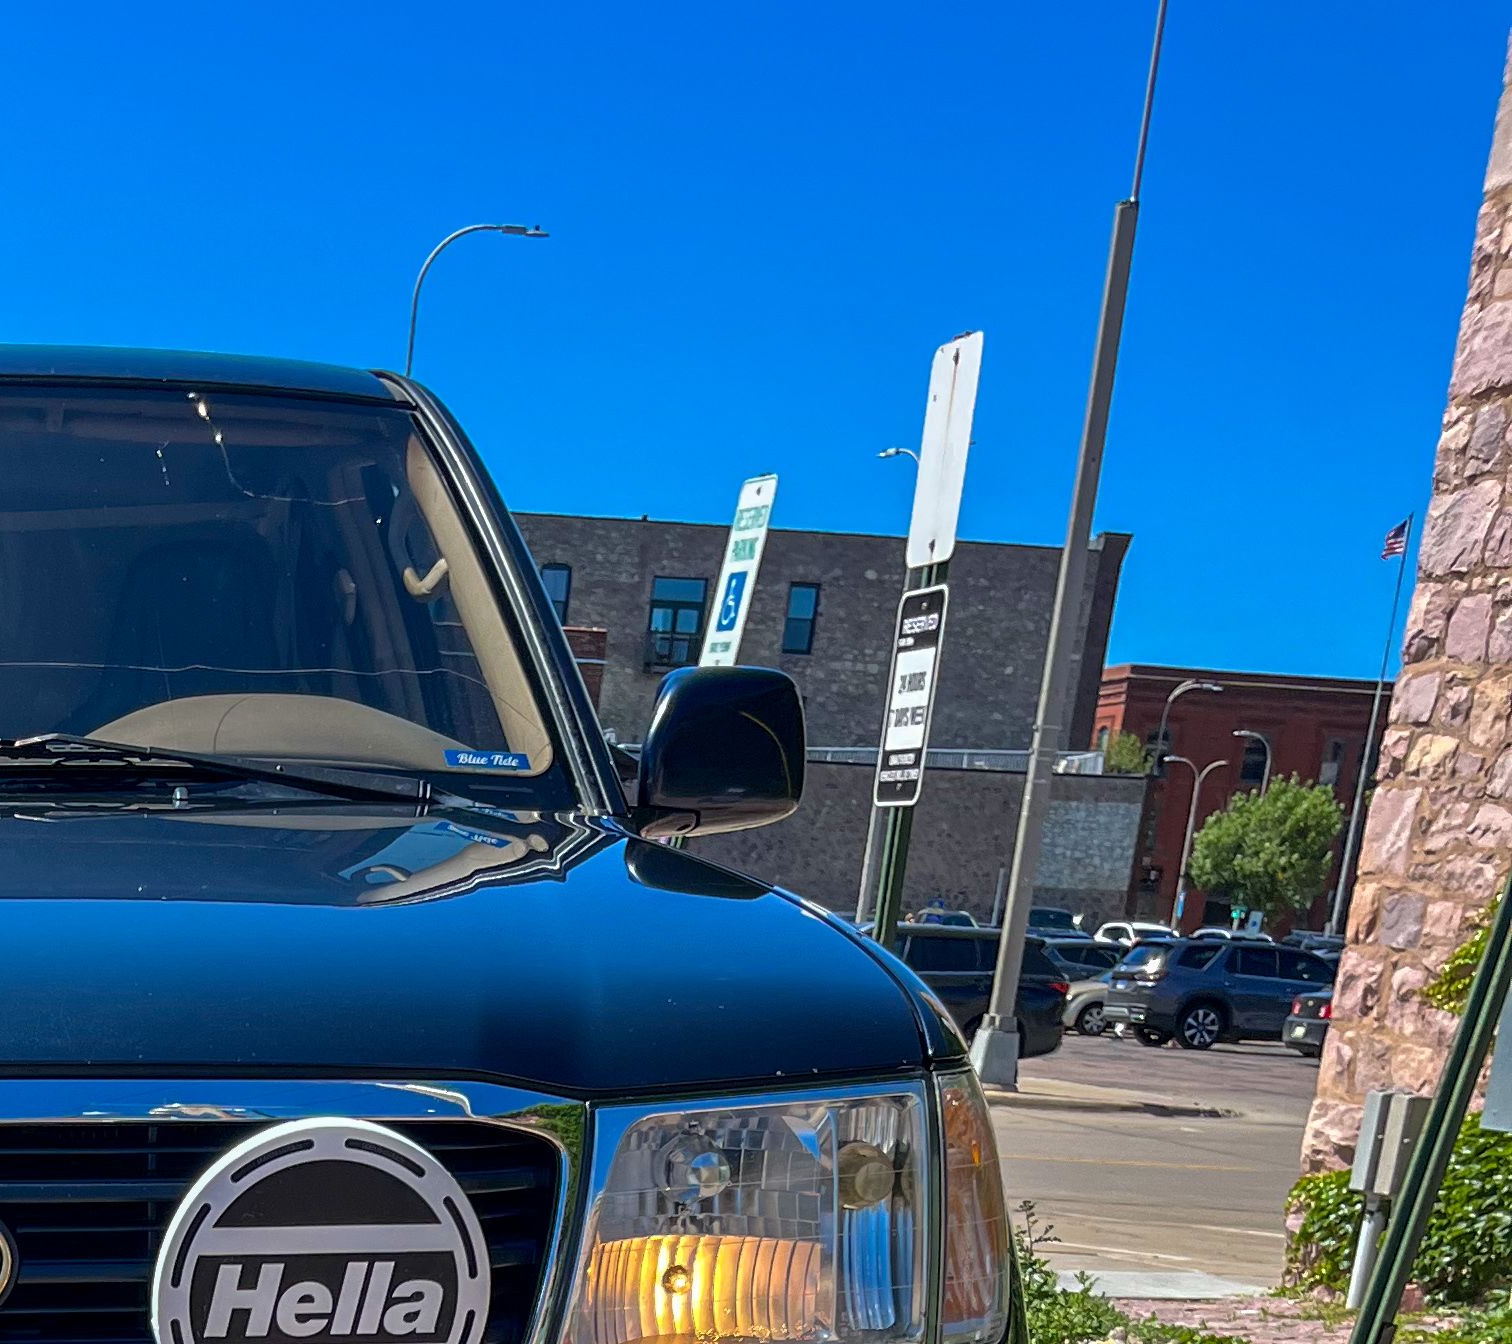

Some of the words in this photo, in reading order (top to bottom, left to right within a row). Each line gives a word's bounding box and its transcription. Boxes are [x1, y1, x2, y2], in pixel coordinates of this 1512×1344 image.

[456, 752, 488, 765] Blue
[490, 754, 519, 767] Tide
[203, 1261, 444, 1339] Hella
